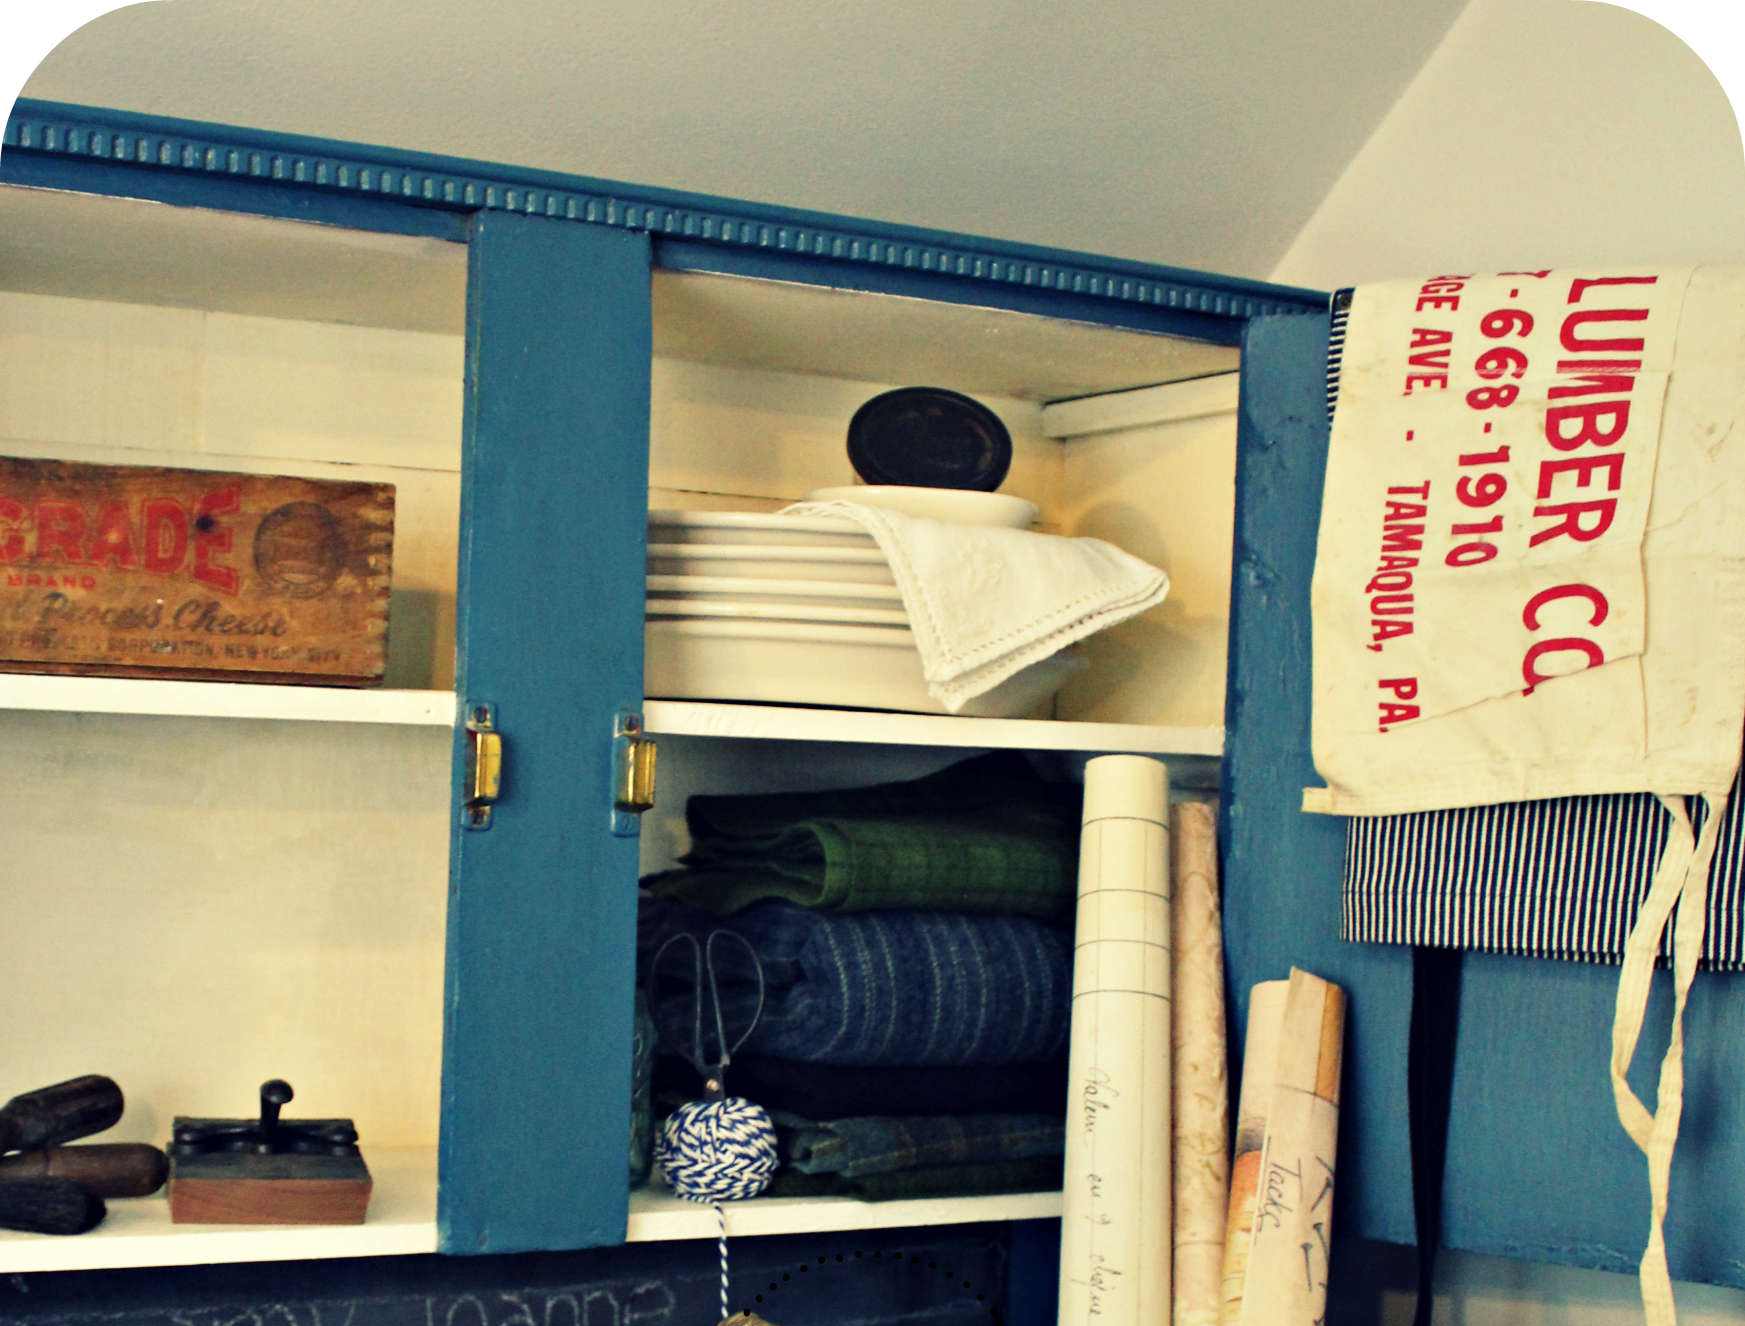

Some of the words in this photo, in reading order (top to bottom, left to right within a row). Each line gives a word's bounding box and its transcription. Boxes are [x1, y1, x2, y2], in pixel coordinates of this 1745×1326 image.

[1528, 276, 1659, 549] LUMBER
[8, 574, 97, 590] BRAND
[1364, 480, 1432, 653] TAMAQUA,
[1257, 1157, 1304, 1233] Tacks
